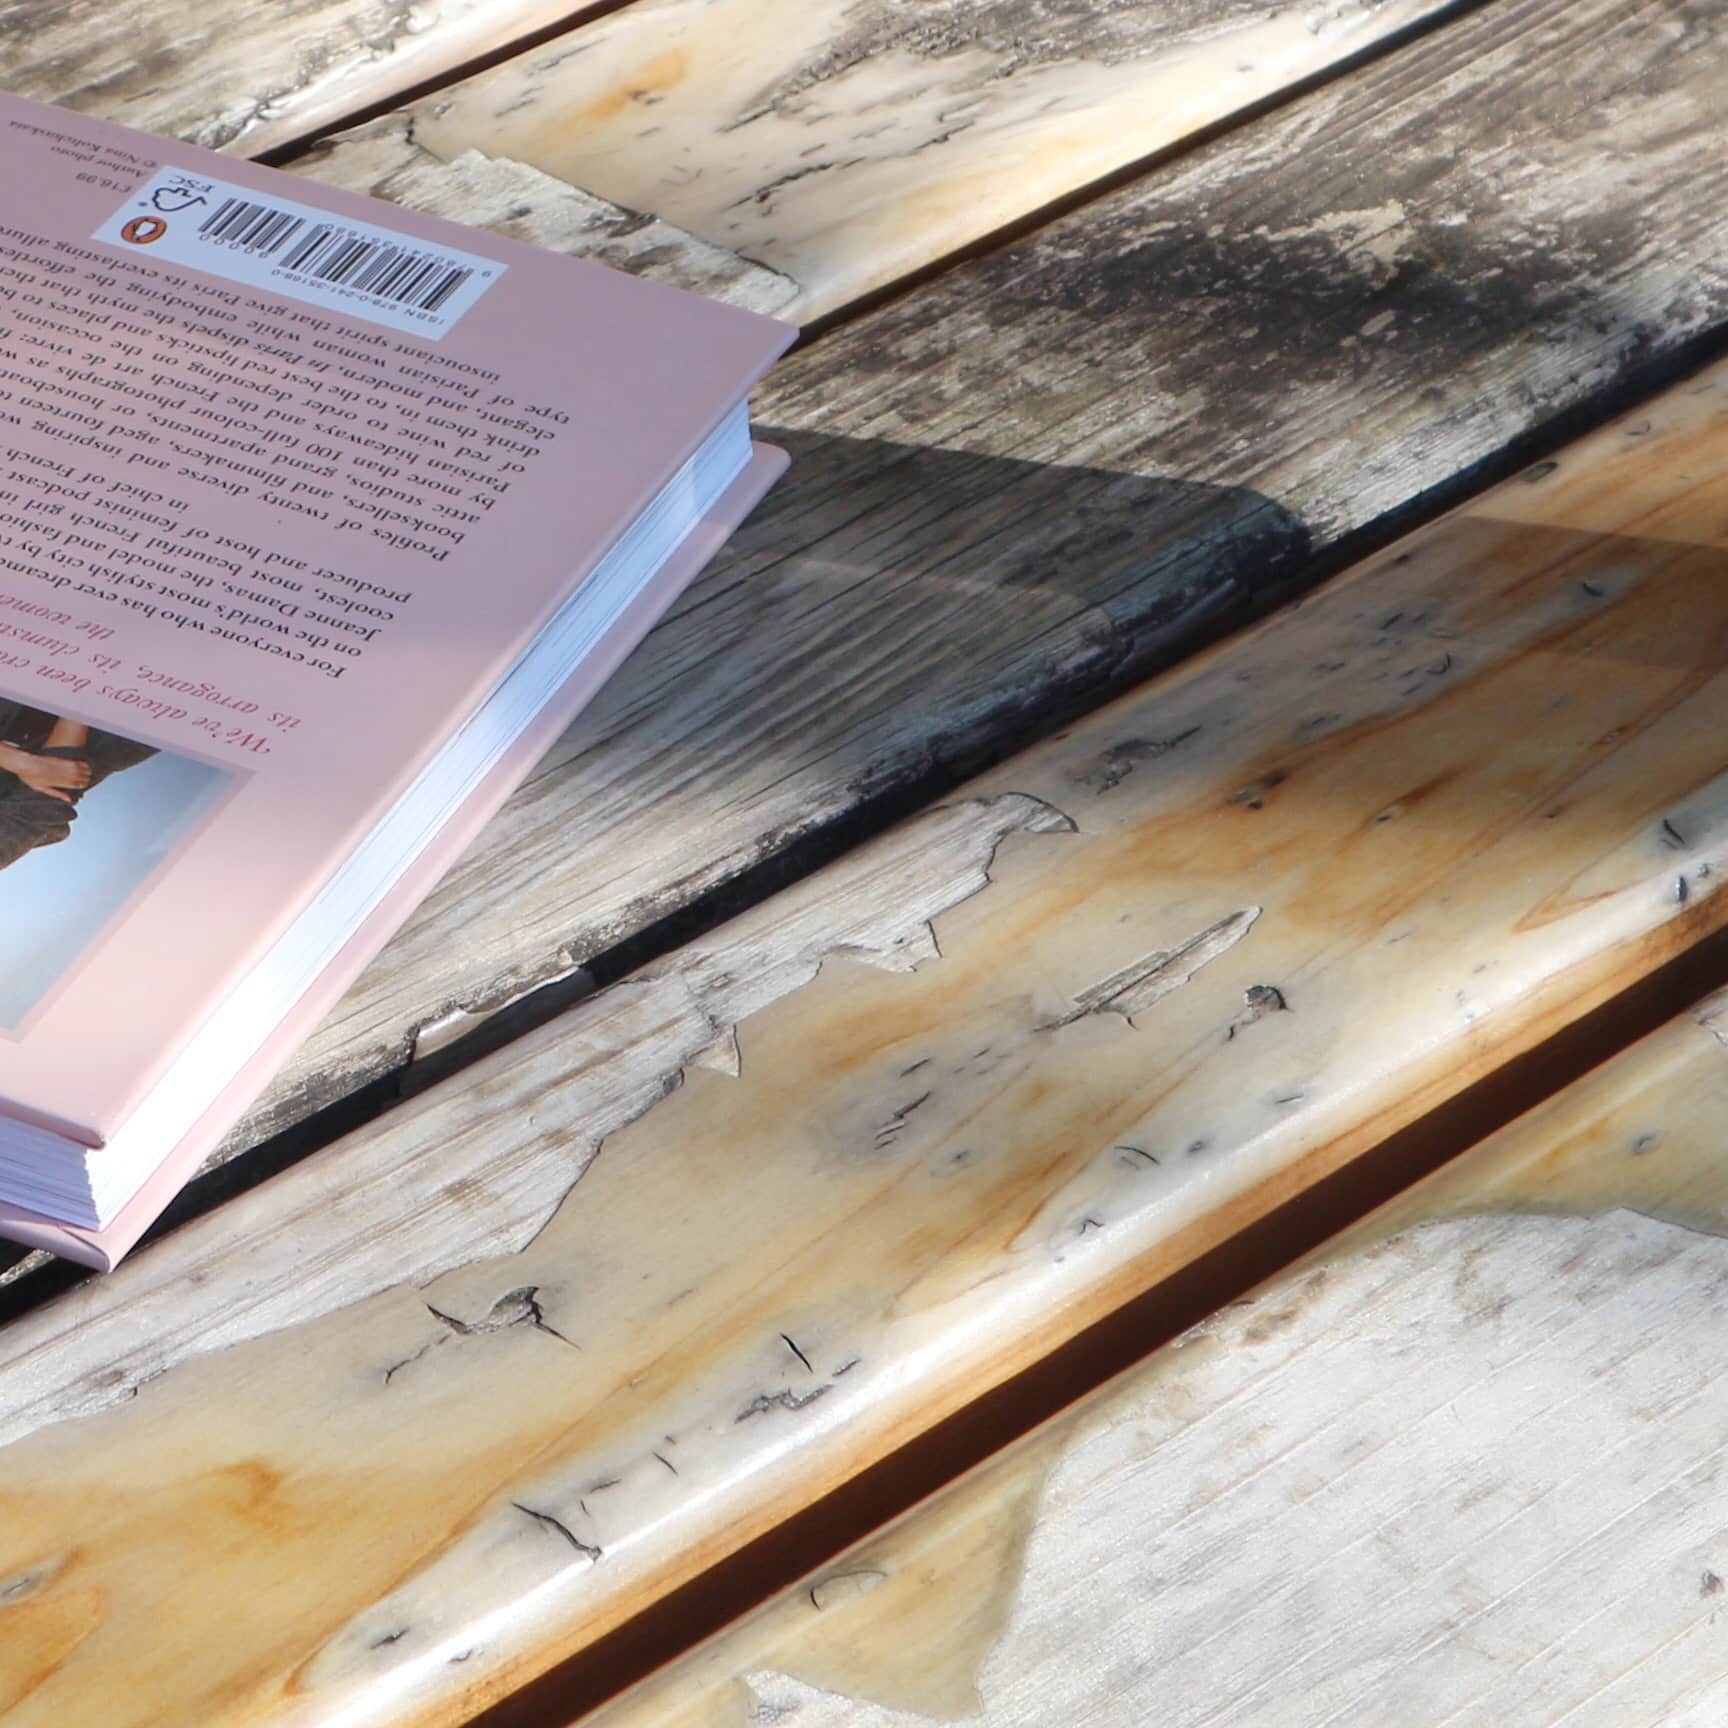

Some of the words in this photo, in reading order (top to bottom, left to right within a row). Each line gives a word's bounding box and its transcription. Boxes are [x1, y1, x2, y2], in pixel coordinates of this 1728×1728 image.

[168, 175, 215, 194] FSC
[53, 241, 159, 278] everlasting
[164, 274, 188, 290] its
[21, 294, 44, 305] to
[192, 283, 242, 306] Paris
[50, 301, 112, 325] places
[244, 299, 289, 316] give
[110, 320, 153, 336] and
[290, 312, 332, 331] that
[335, 326, 388, 347] spirit
[158, 334, 239, 367] lipsticks
[29, 357, 50, 368] as
[240, 360, 277, 375] red
[394, 343, 501, 385] insouciant
[56, 365, 187, 410] photographs
[281, 371, 324, 393] best
[327, 386, 361, 402] the
[366, 397, 388, 410] to
[189, 407, 301, 448] full-colour
[426, 415, 479, 438] them
[31, 420, 123, 459] inspiring
[483, 432, 541, 458] drink
[6, 448, 76, 478] French
[127, 452, 171, 469] and
[305, 443, 343, 462] 100
[77, 472, 106, 484] of
[352, 456, 400, 478] than
[7, 471, 92, 501] podcast
[106, 481, 164, 503] chief
[177, 467, 250, 497] diverse
[407, 473, 462, 496] more
[23, 498, 65, 515] girl
[168, 498, 190, 514] in
[257, 491, 329, 521] twenty
[469, 492, 496, 511] by
[93, 498, 179, 533] feminist
[334, 518, 363, 530] of
[70, 512, 140, 543] French
[180, 527, 210, 539] of
[16, 540, 43, 559] by
[62, 534, 107, 551] and
[215, 536, 261, 560] host
[373, 528, 450, 562] Profiles
[46, 549, 85, 568] city
[107, 548, 177, 574] model
[145, 537, 243, 577] beautiful
[263, 552, 308, 570] and
[88, 563, 156, 590] stylish
[180, 570, 214, 588] the
[250, 569, 304, 592] most
[311, 568, 413, 603] producer
[73, 583, 119, 601] ever
[157, 586, 212, 609] most
[120, 597, 158, 619] has
[75, 621, 116, 641] the
[160, 610, 205, 631] who
[304, 610, 383, 642] Jeanne
[210, 626, 305, 662] everyone
[295, 630, 330, 648] the
[333, 642, 362, 657] on
[87, 653, 122, 674] its
[306, 658, 347, 679] For
[35, 665, 92, 693] been
[96, 685, 188, 720] always
[266, 711, 301, 733] its
